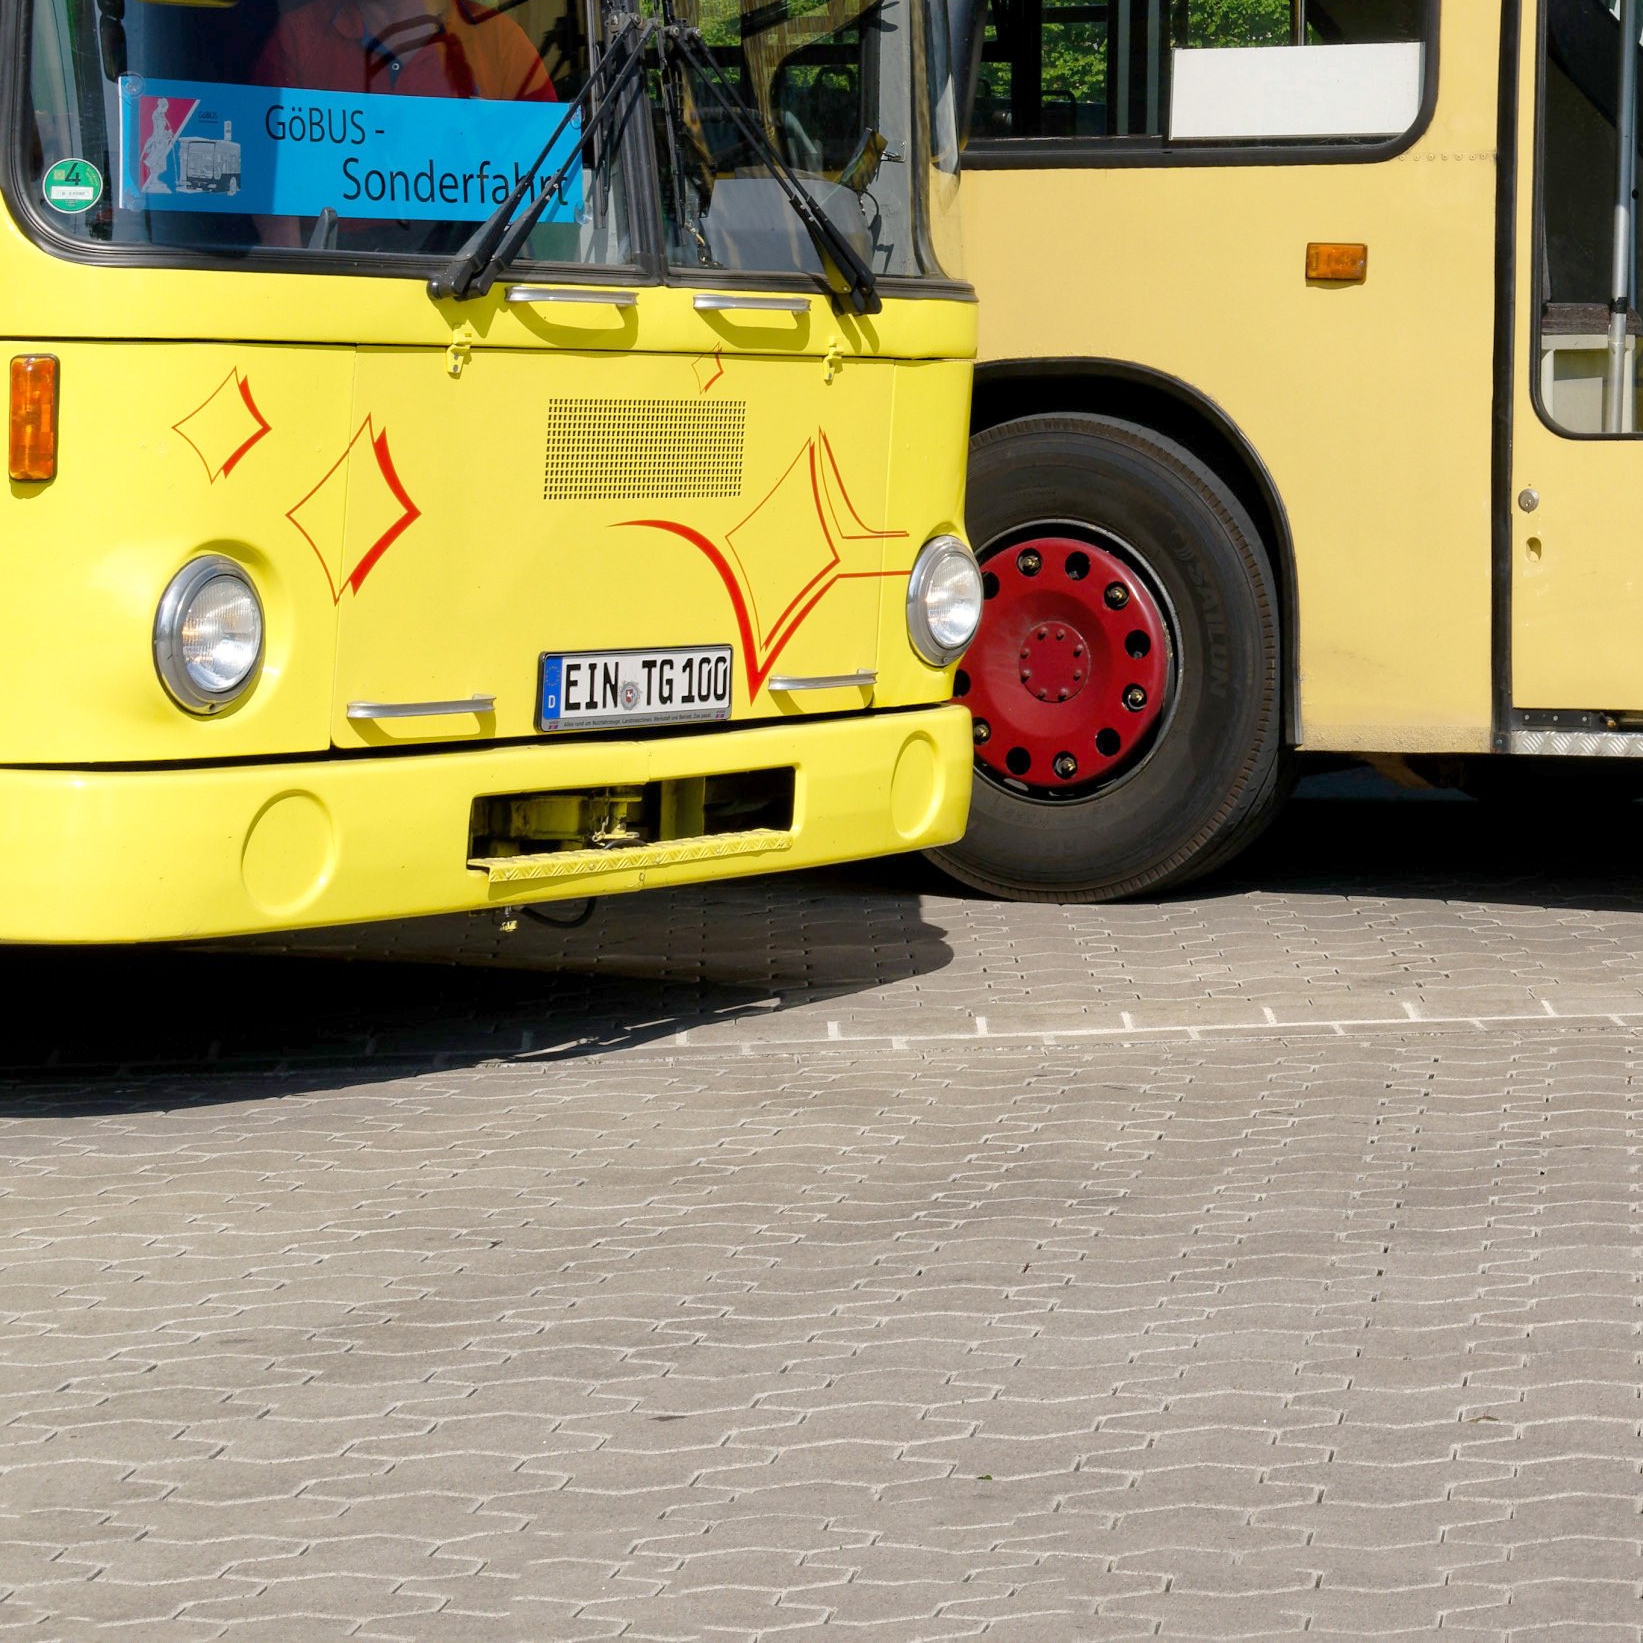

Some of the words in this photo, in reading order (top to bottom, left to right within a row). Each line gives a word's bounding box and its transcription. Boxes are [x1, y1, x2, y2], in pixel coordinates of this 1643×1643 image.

[265, 104, 366, 145] GöBUS
[64, 162, 81, 186] 4
[343, 157, 568, 206] Sonderfahrt
[548, 695, 556, 708] D
[565, 661, 619, 711] EIN
[642, 659, 674, 706] TG
[681, 656, 728, 703] 100
